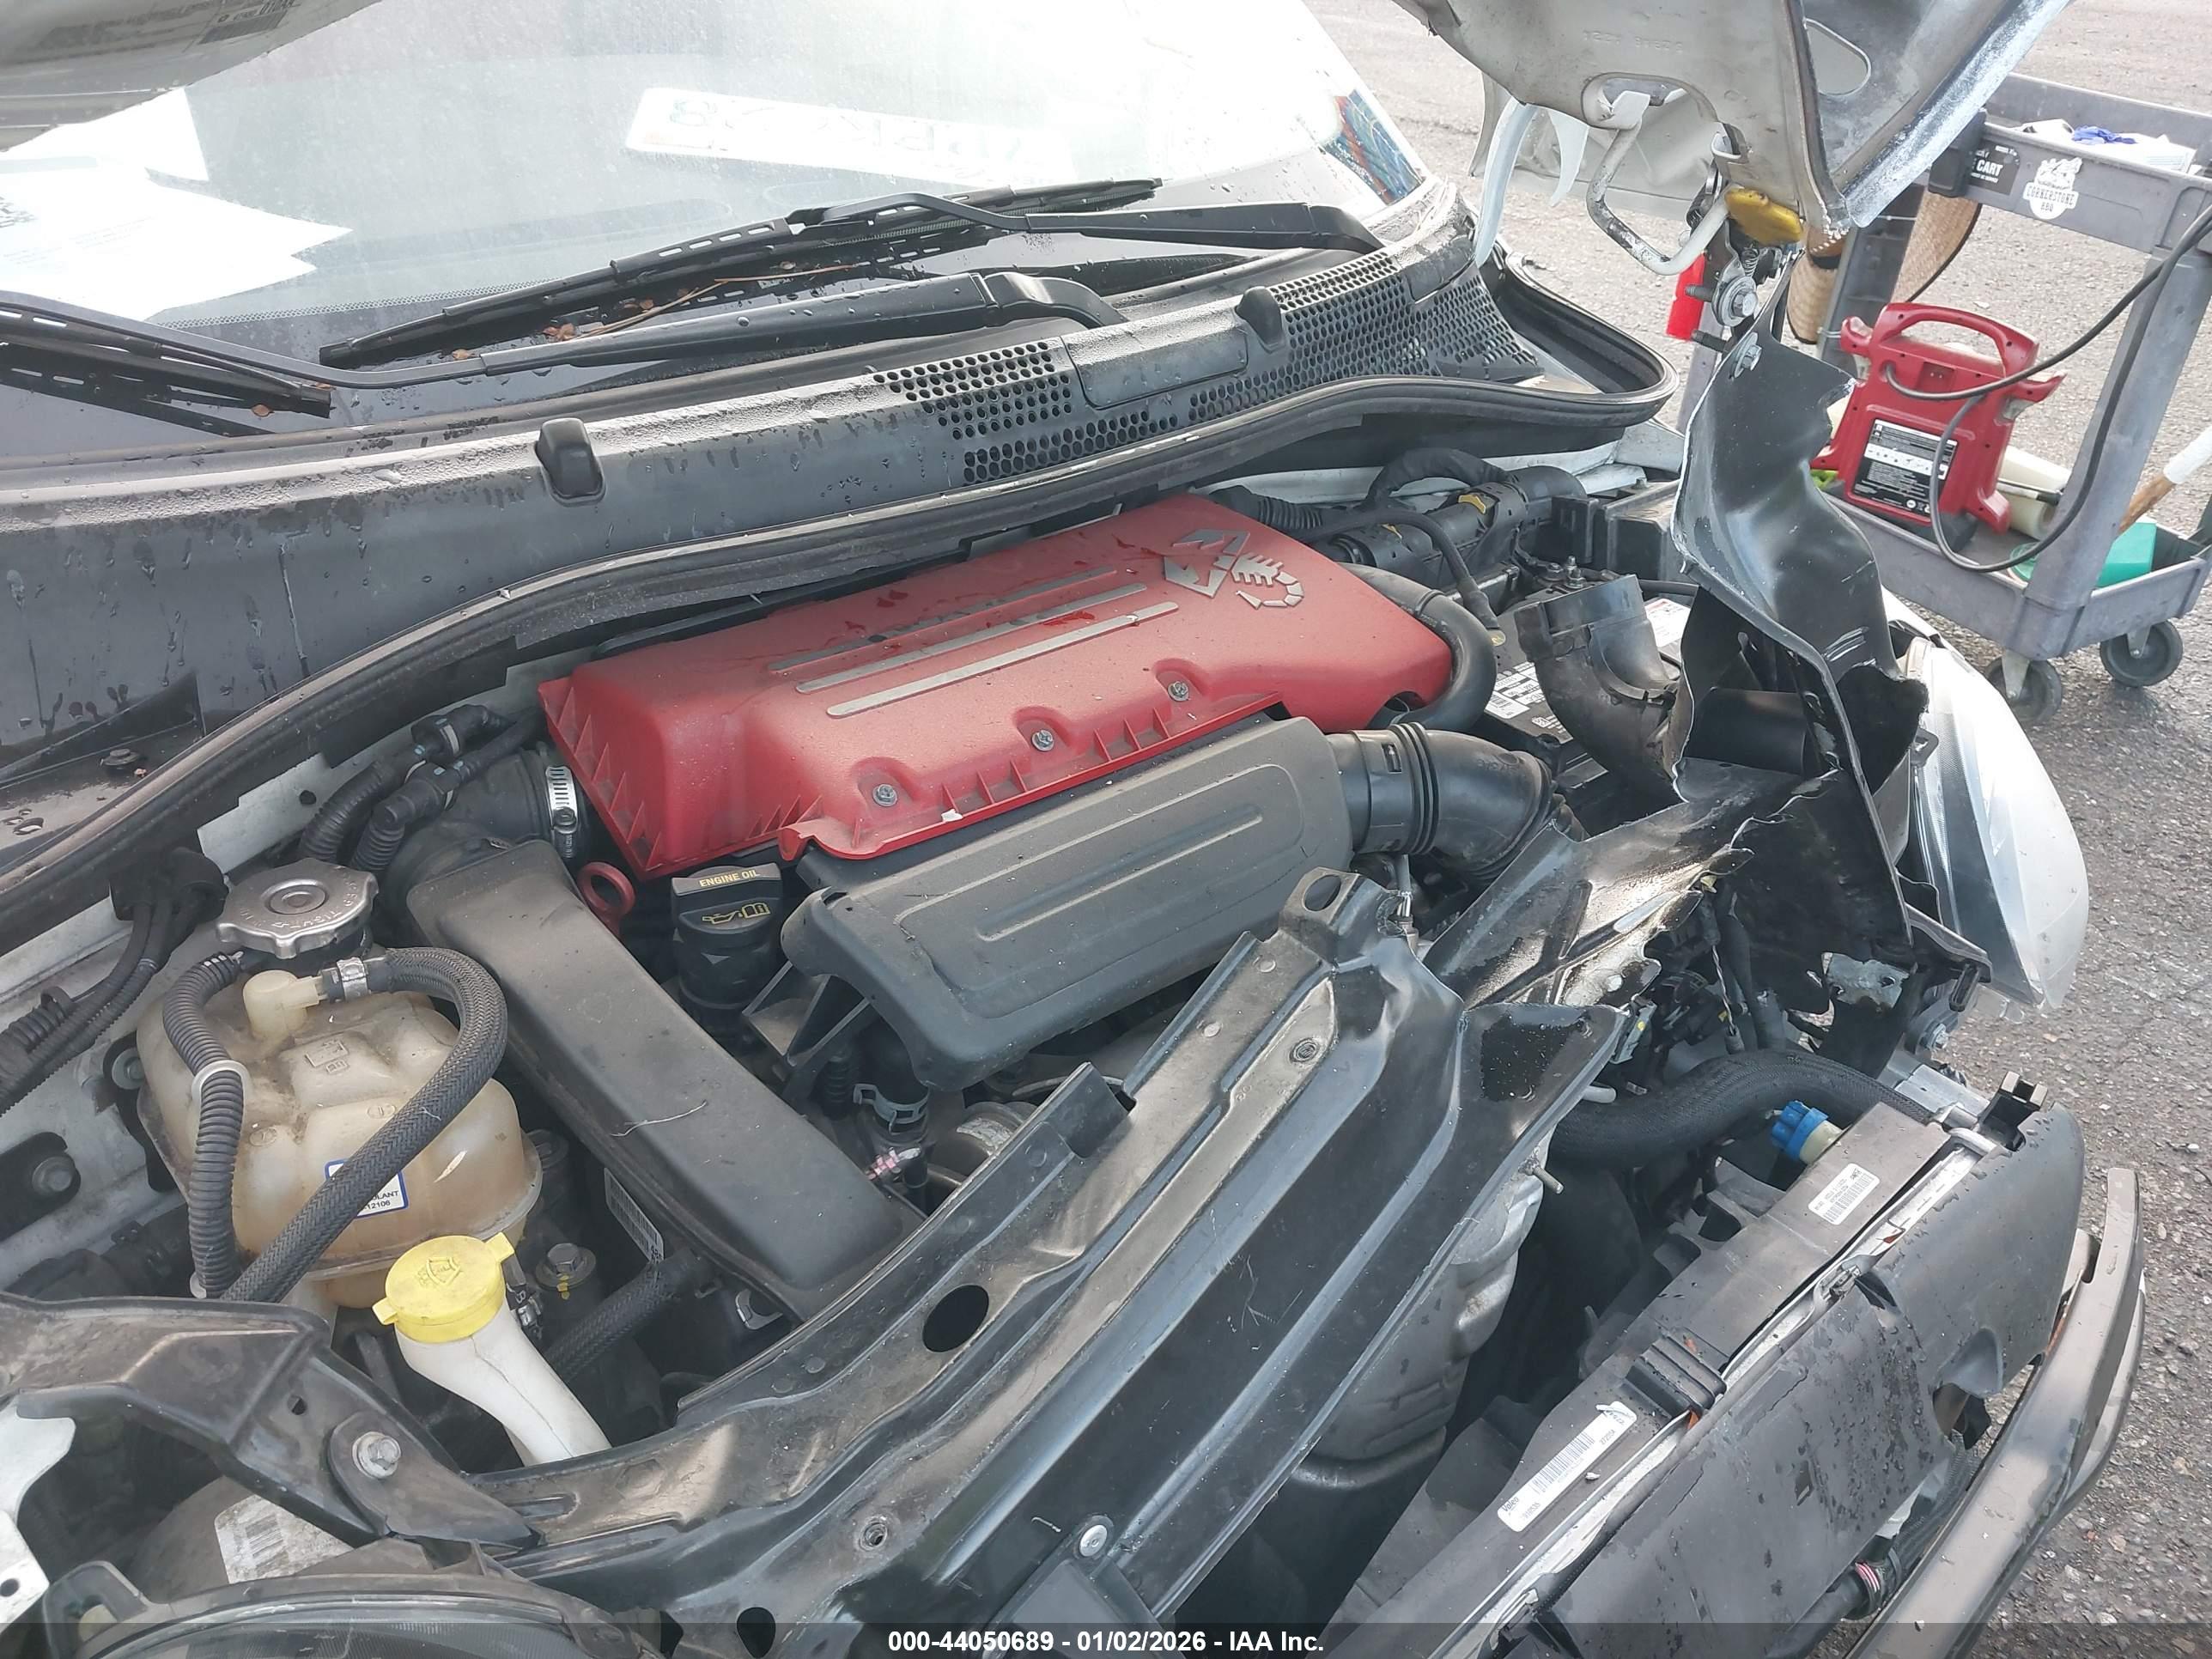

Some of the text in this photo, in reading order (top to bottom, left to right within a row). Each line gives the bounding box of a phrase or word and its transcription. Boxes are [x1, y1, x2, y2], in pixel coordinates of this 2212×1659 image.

[1977, 160, 2003, 177] CART
[699, 869, 761, 887] ENGINE OIL
[1502, 1496, 1519, 1512] Valeo
